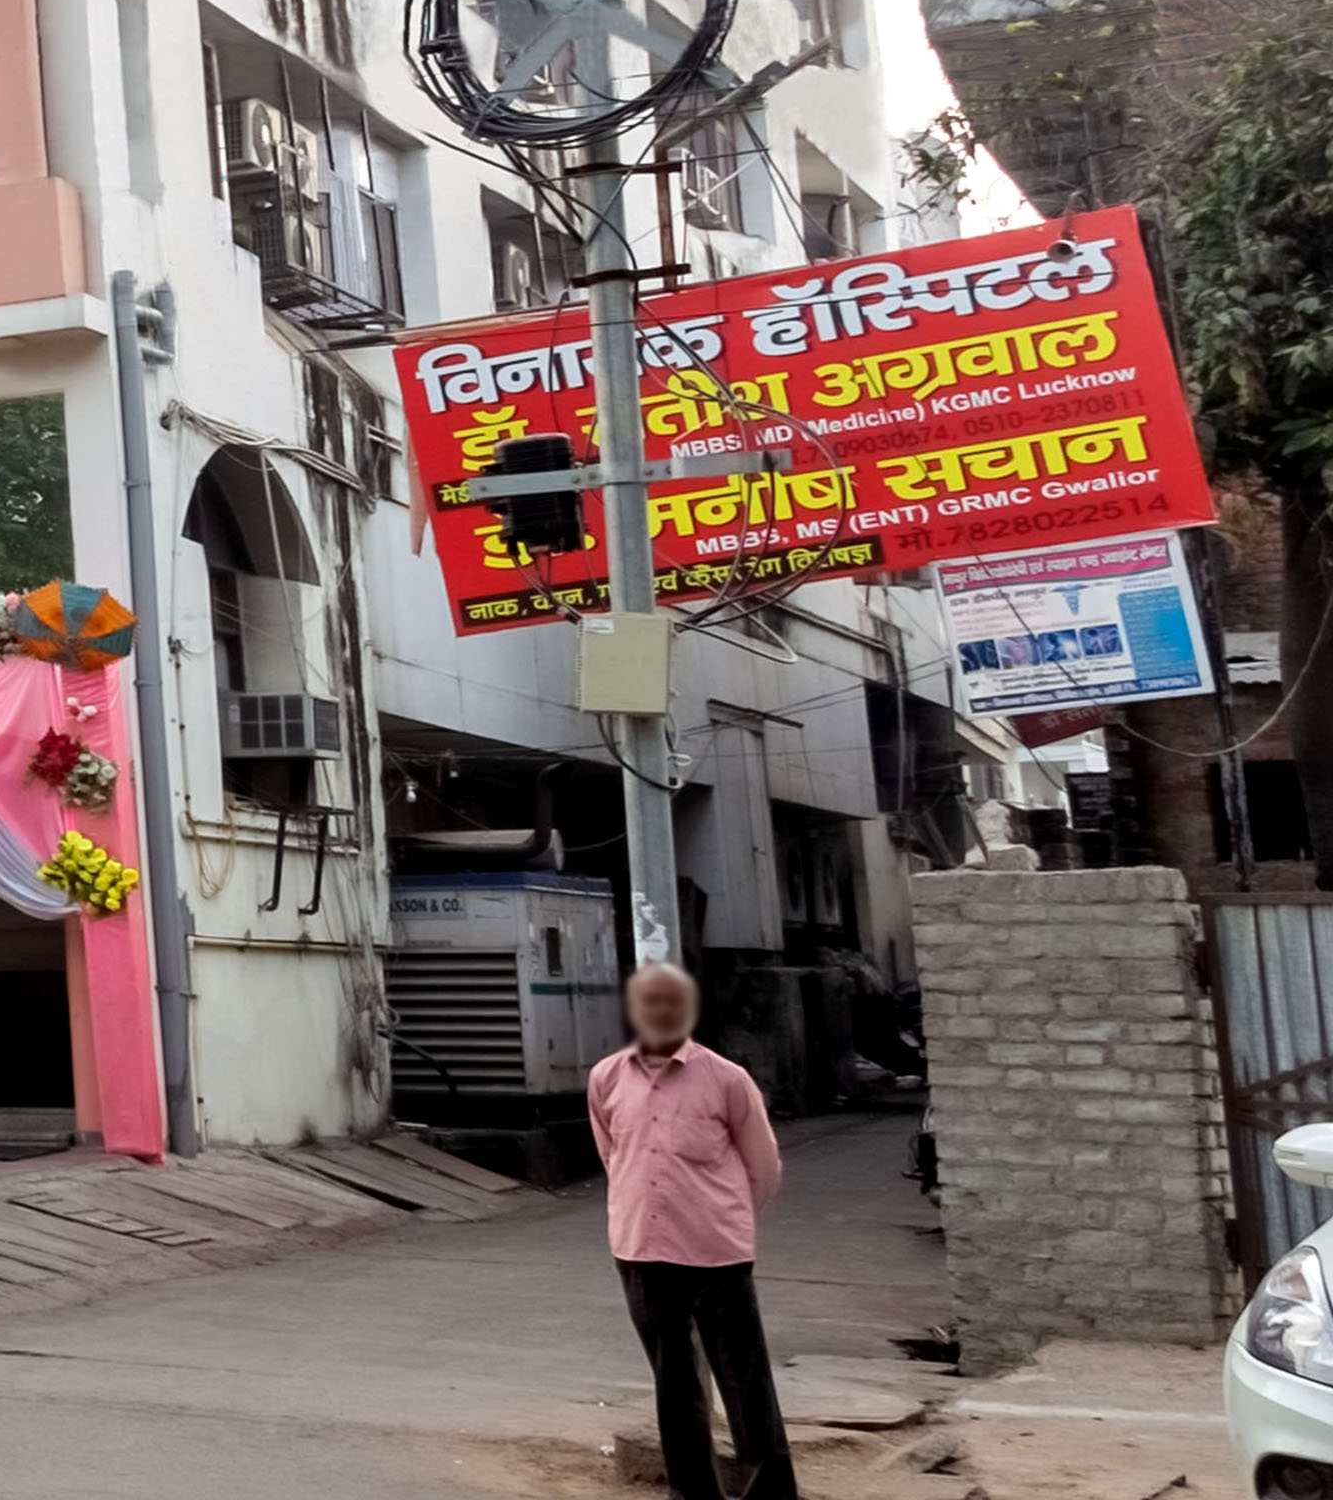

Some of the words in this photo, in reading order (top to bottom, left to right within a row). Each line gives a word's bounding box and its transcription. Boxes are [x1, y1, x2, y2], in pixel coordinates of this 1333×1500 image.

[416, 314, 724, 414] विनाक
[742, 237, 1117, 357] हॉस्पिटल
[813, 310, 1118, 408] अग्रवाल
[754, 424, 793, 447] MD
[933, 385, 1012, 415] KGMC
[1019, 366, 1137, 400] Lucknow
[964, 388, 1146, 437] 0510-2370811
[876, 415, 1148, 501] सचान
[695, 528, 790, 556] MBBS,
[795, 517, 839, 540] MS
[850, 504, 930, 534] (ENT)
[937, 487, 1033, 516] GRMC
[1040, 467, 1161, 500] Gwalior
